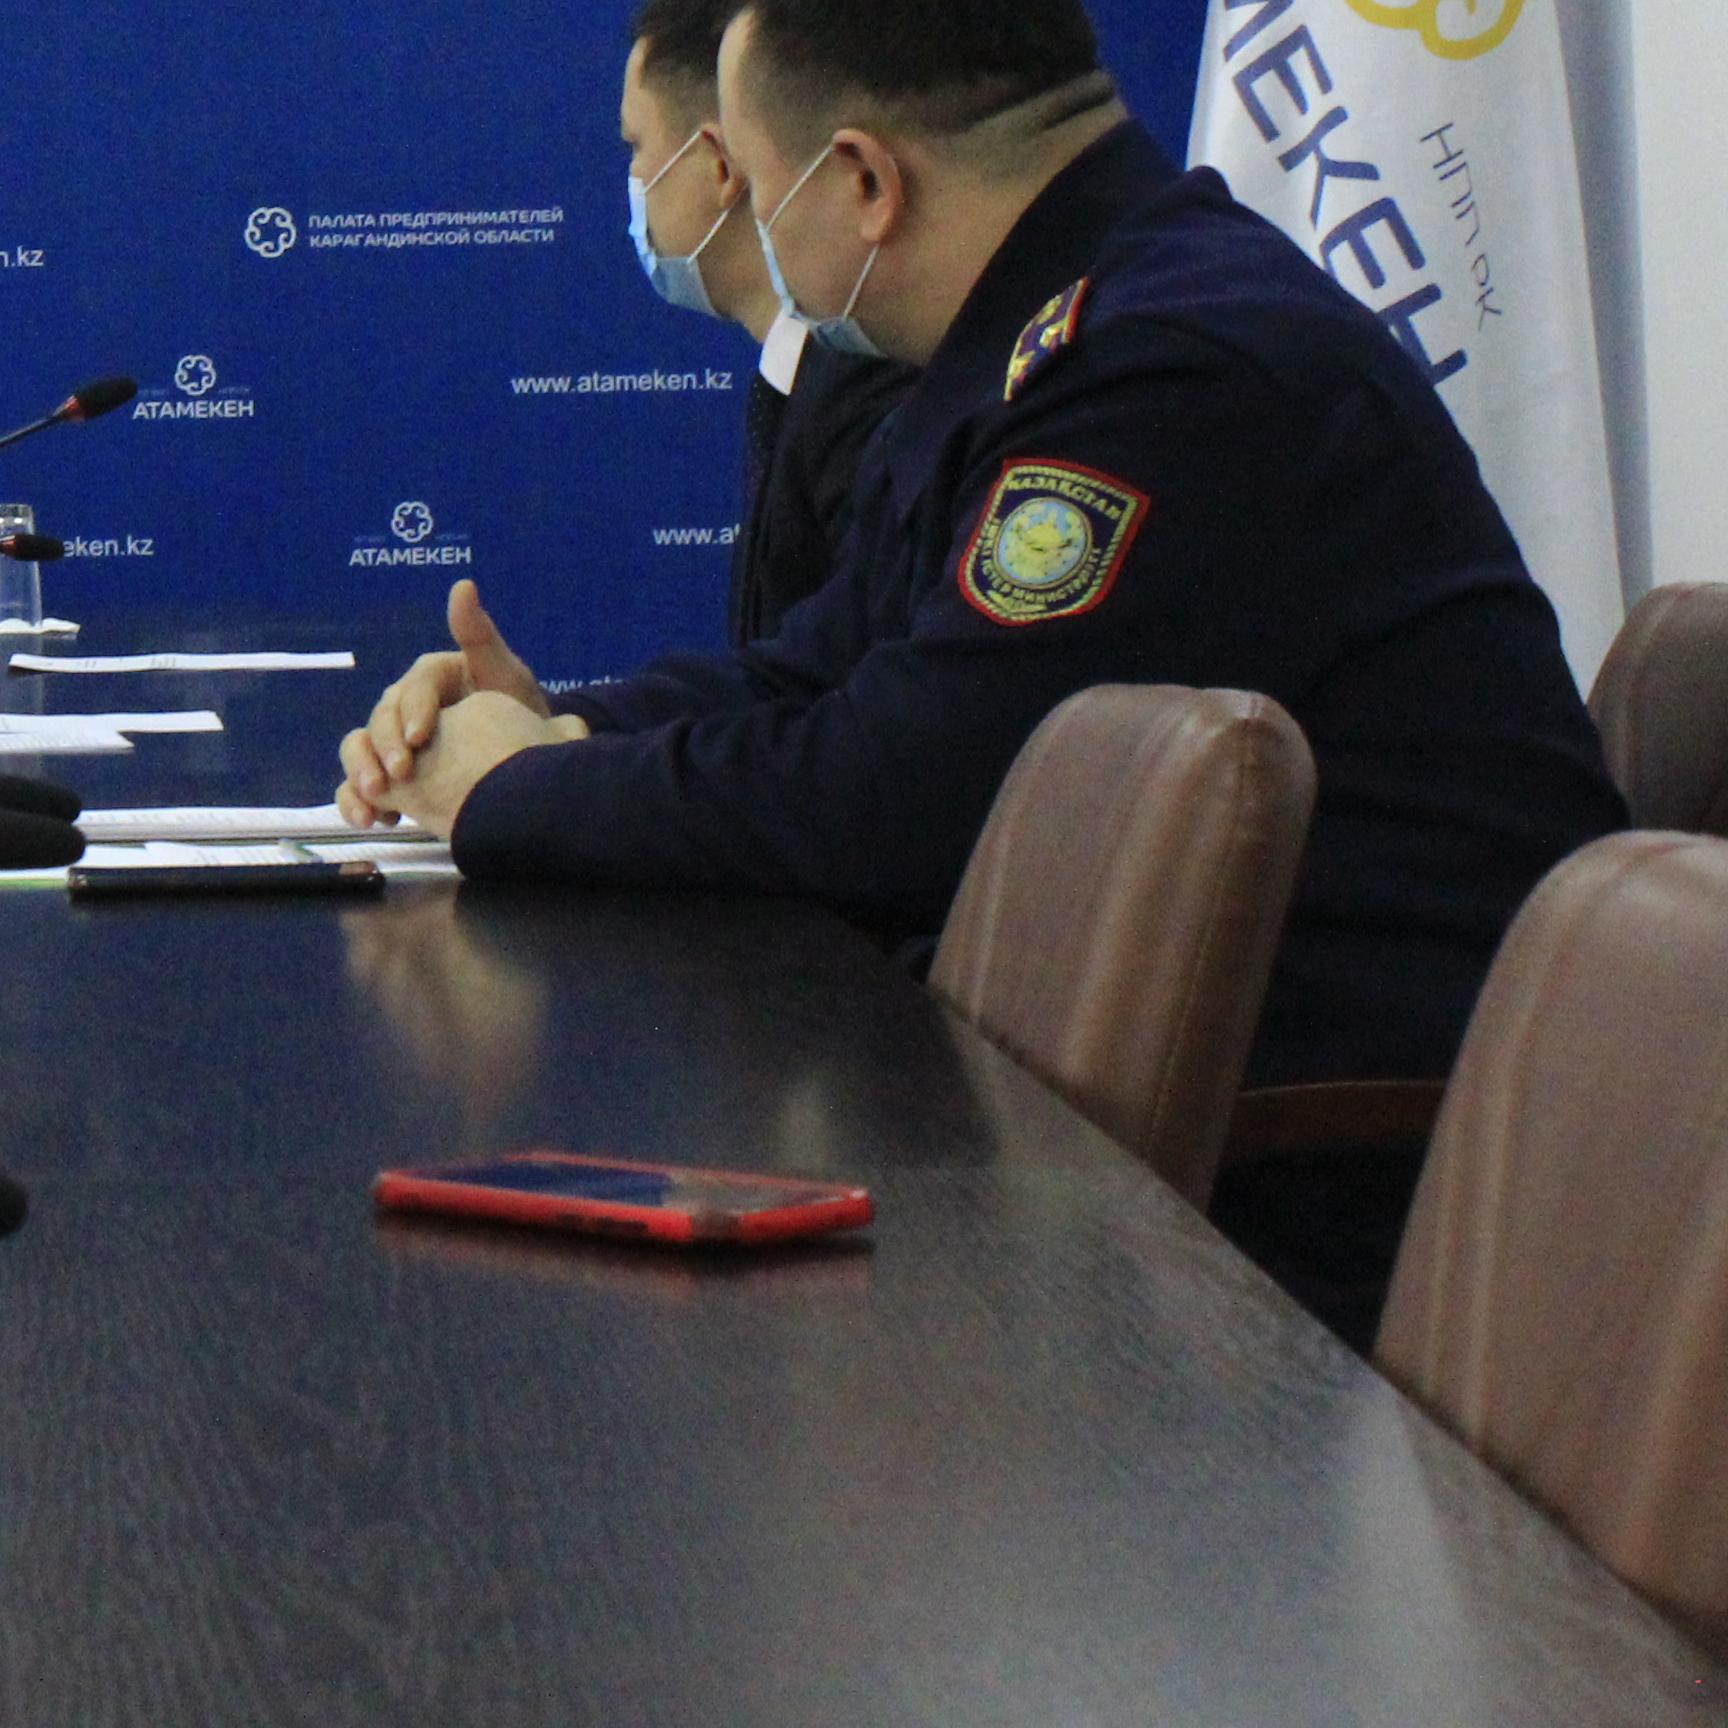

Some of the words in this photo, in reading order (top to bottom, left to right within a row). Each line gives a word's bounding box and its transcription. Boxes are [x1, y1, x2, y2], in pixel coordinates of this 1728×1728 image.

[308, 213, 376, 229] ПАЛАТА
[380, 206, 565, 229] ПРЕДПРИНИМАТЕЛЕЙ
[309, 229, 470, 248] КАРАГАНДИНСКОЙ
[474, 228, 555, 245] ОБЛАСТИ
[511, 368, 733, 394] www.atameken.kz
[132, 399, 255, 420] АТАМЕКЕН
[348, 545, 472, 567] АТАМЕКЕН
